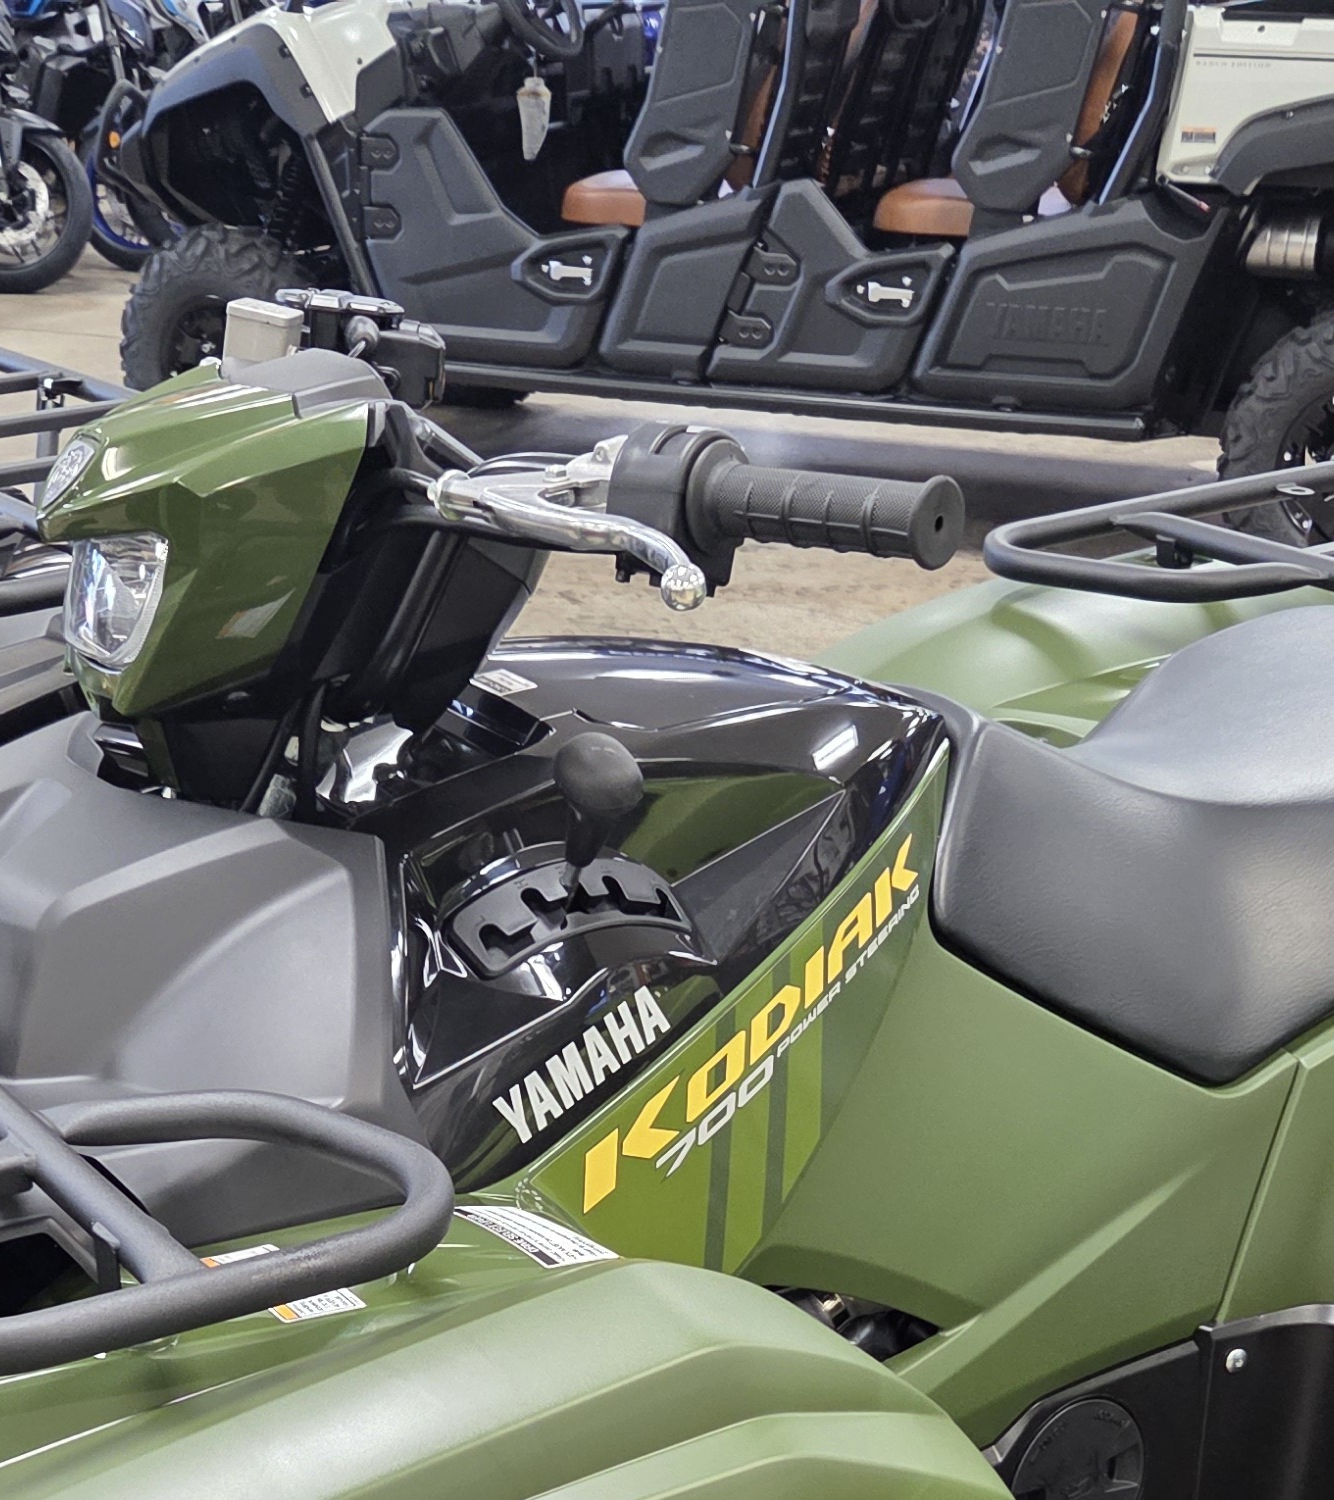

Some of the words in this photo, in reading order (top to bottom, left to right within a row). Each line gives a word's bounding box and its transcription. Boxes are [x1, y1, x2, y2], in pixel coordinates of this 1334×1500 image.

[583, 833, 918, 1213] KODIAK
[777, 981, 841, 1057] POWER
[845, 884, 920, 984] STEERING
[492, 985, 671, 1144] YAMAHA
[655, 1054, 774, 1178] 700
